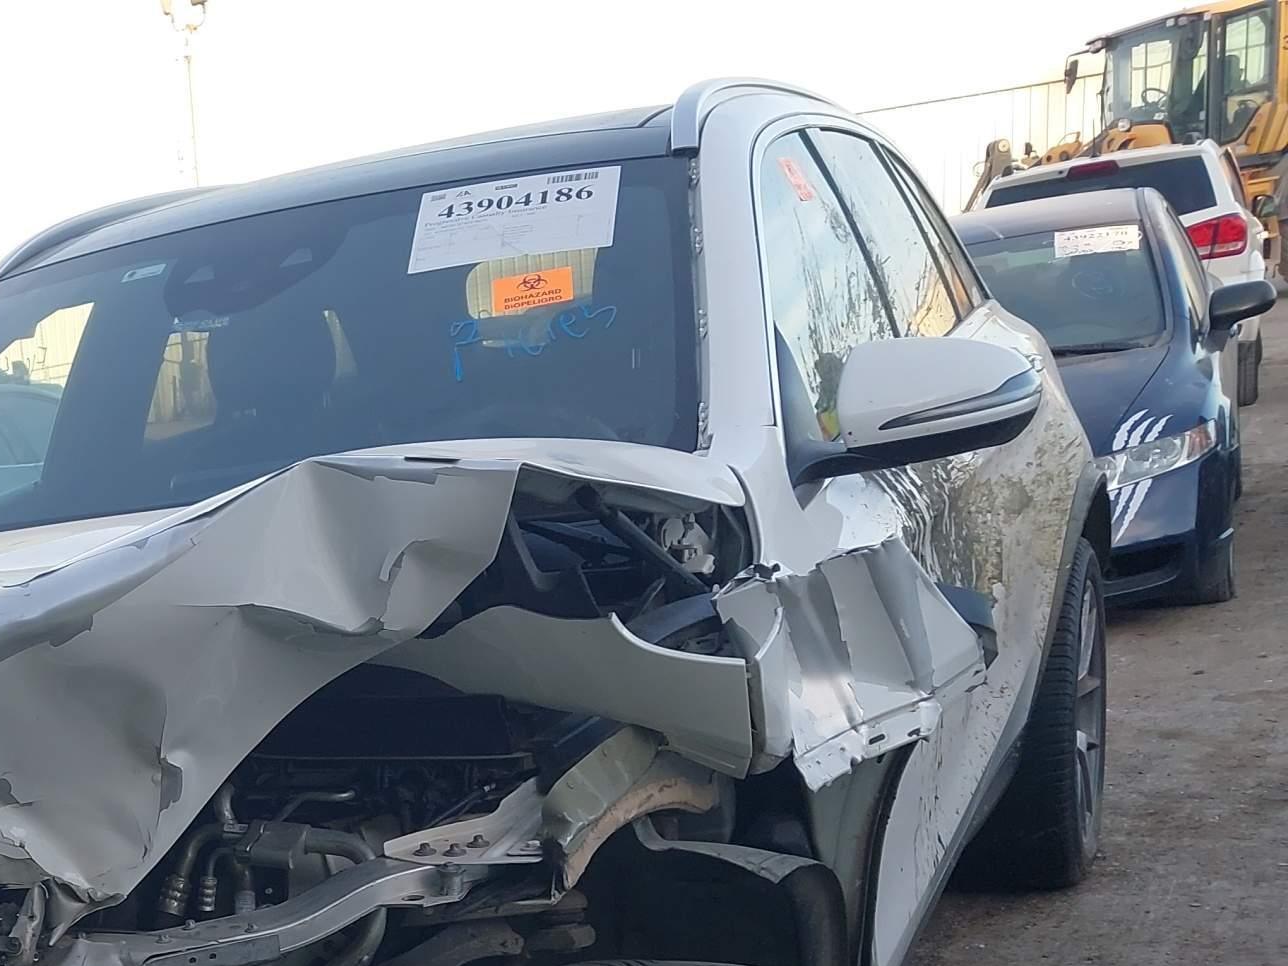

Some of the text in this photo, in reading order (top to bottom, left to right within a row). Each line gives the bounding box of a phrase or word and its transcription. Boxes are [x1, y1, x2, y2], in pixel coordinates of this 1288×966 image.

[437, 184, 594, 219] 43904186
[504, 288, 562, 303] BIOHAZARD
[504, 295, 562, 310] BIOPELIGRO
